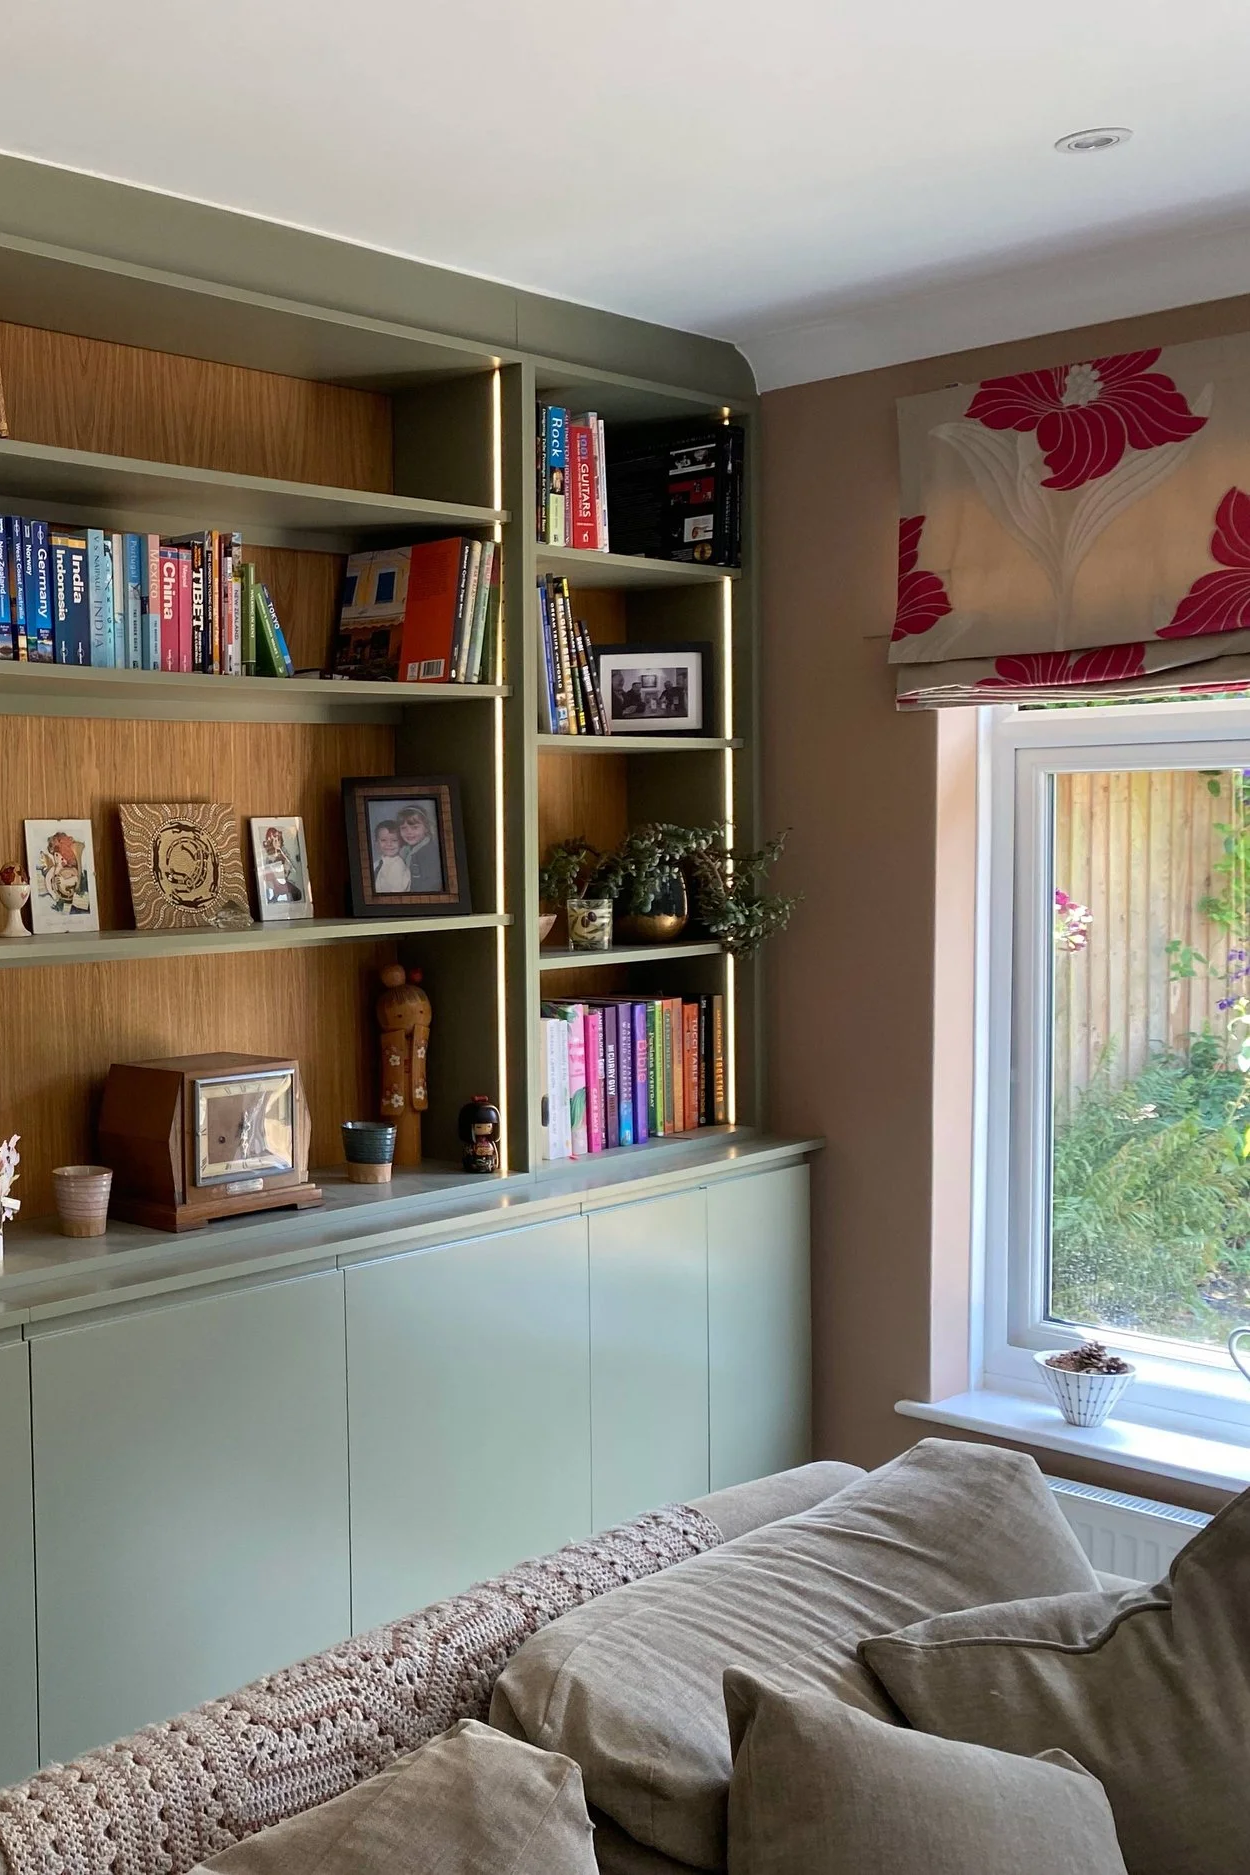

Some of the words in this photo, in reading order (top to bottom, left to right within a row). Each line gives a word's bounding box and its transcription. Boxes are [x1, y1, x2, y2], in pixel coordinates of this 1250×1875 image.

[551, 417, 563, 457] Rock
[580, 433, 588, 460] 1001
[581, 463, 591, 517] GUITARS
[25, 544, 33, 576] Norway
[71, 554, 84, 604] India
[93, 555, 101, 592] NAIPAUL
[130, 540, 138, 578] Portugal
[150, 549, 159, 599] Mexico
[17, 586, 25, 620] Australia
[37, 548, 48, 618] Germany
[56, 549, 68, 621] Indonesia
[163, 561, 176, 620] China
[192, 568, 204, 631] TIBET
[94, 600, 103, 649] INDIA
[267, 601, 280, 630] TOKYO
[558, 597, 567, 645] BELGIAN
[562, 647, 571, 676] BEER
[566, 678, 575, 718] TRAILS
[607, 1052, 615, 1079] CURRY
[637, 1039, 647, 1083] Bible
[608, 1079, 616, 1096] GUY
